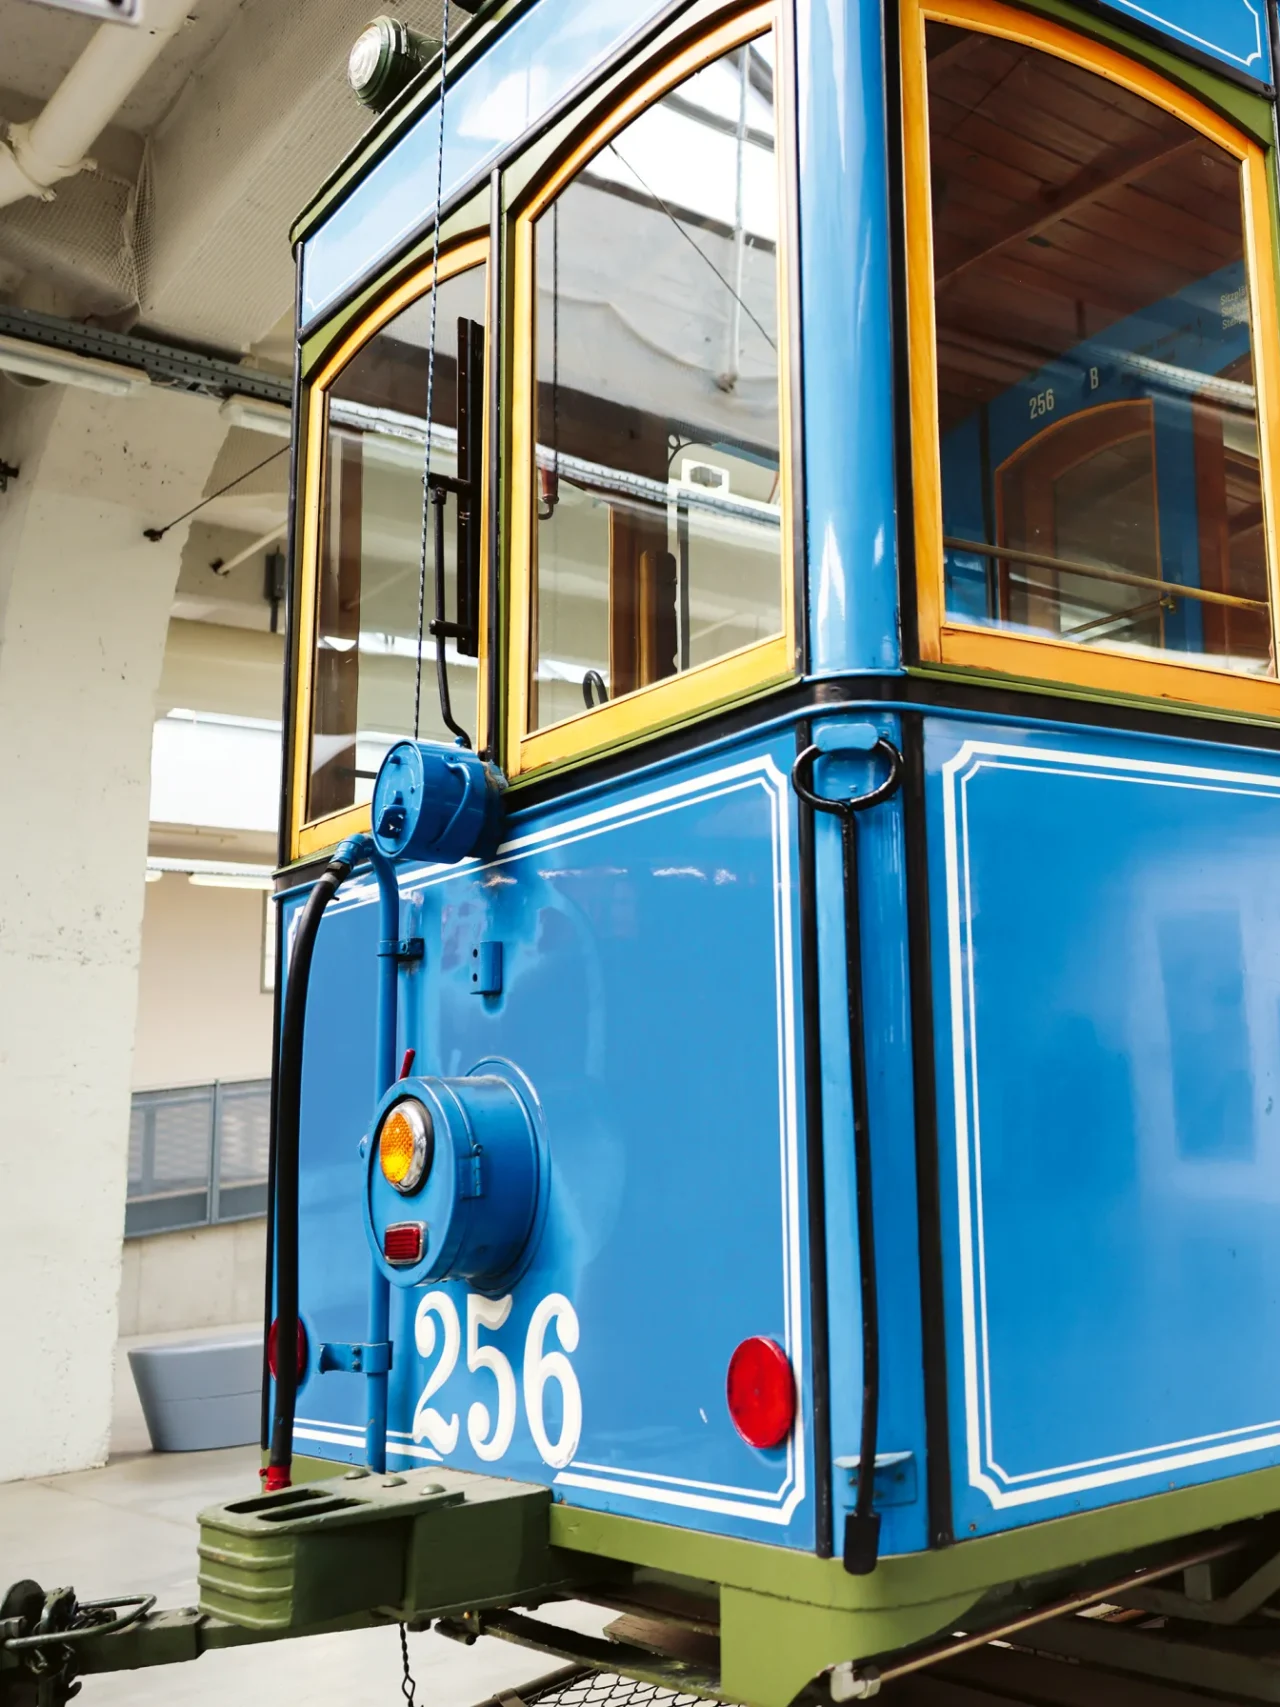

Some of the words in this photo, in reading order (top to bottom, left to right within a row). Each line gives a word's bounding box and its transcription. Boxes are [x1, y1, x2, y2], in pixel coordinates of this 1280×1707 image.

[1029, 388, 1054, 419] 256
[1089, 366, 1099, 390] B
[412, 1290, 583, 1469] 256
